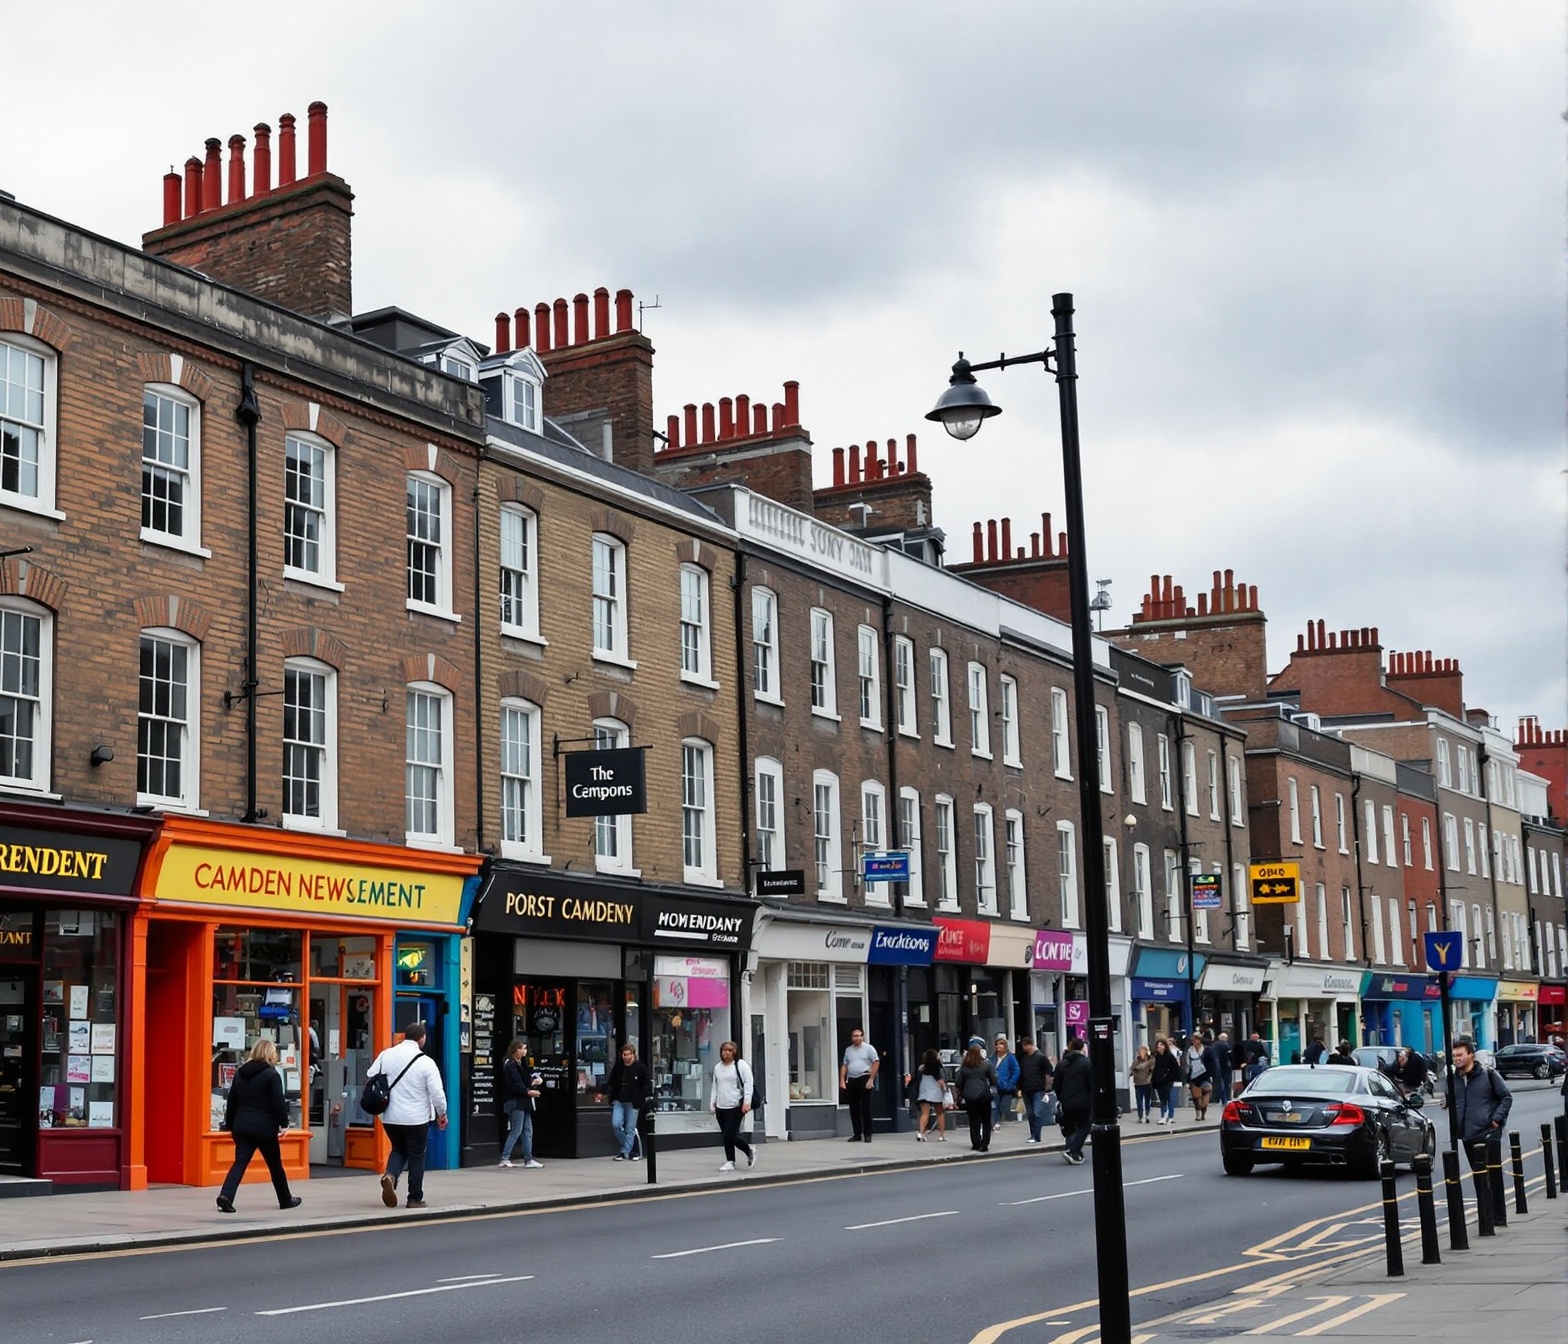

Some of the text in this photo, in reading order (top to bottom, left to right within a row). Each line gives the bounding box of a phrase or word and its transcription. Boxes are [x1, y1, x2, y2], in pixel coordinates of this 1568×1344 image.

[590, 765, 614, 781] The
[194, 863, 426, 909] CAMDEN NEWSEMENT
[505, 892, 634, 924] PORST CAMDENY
